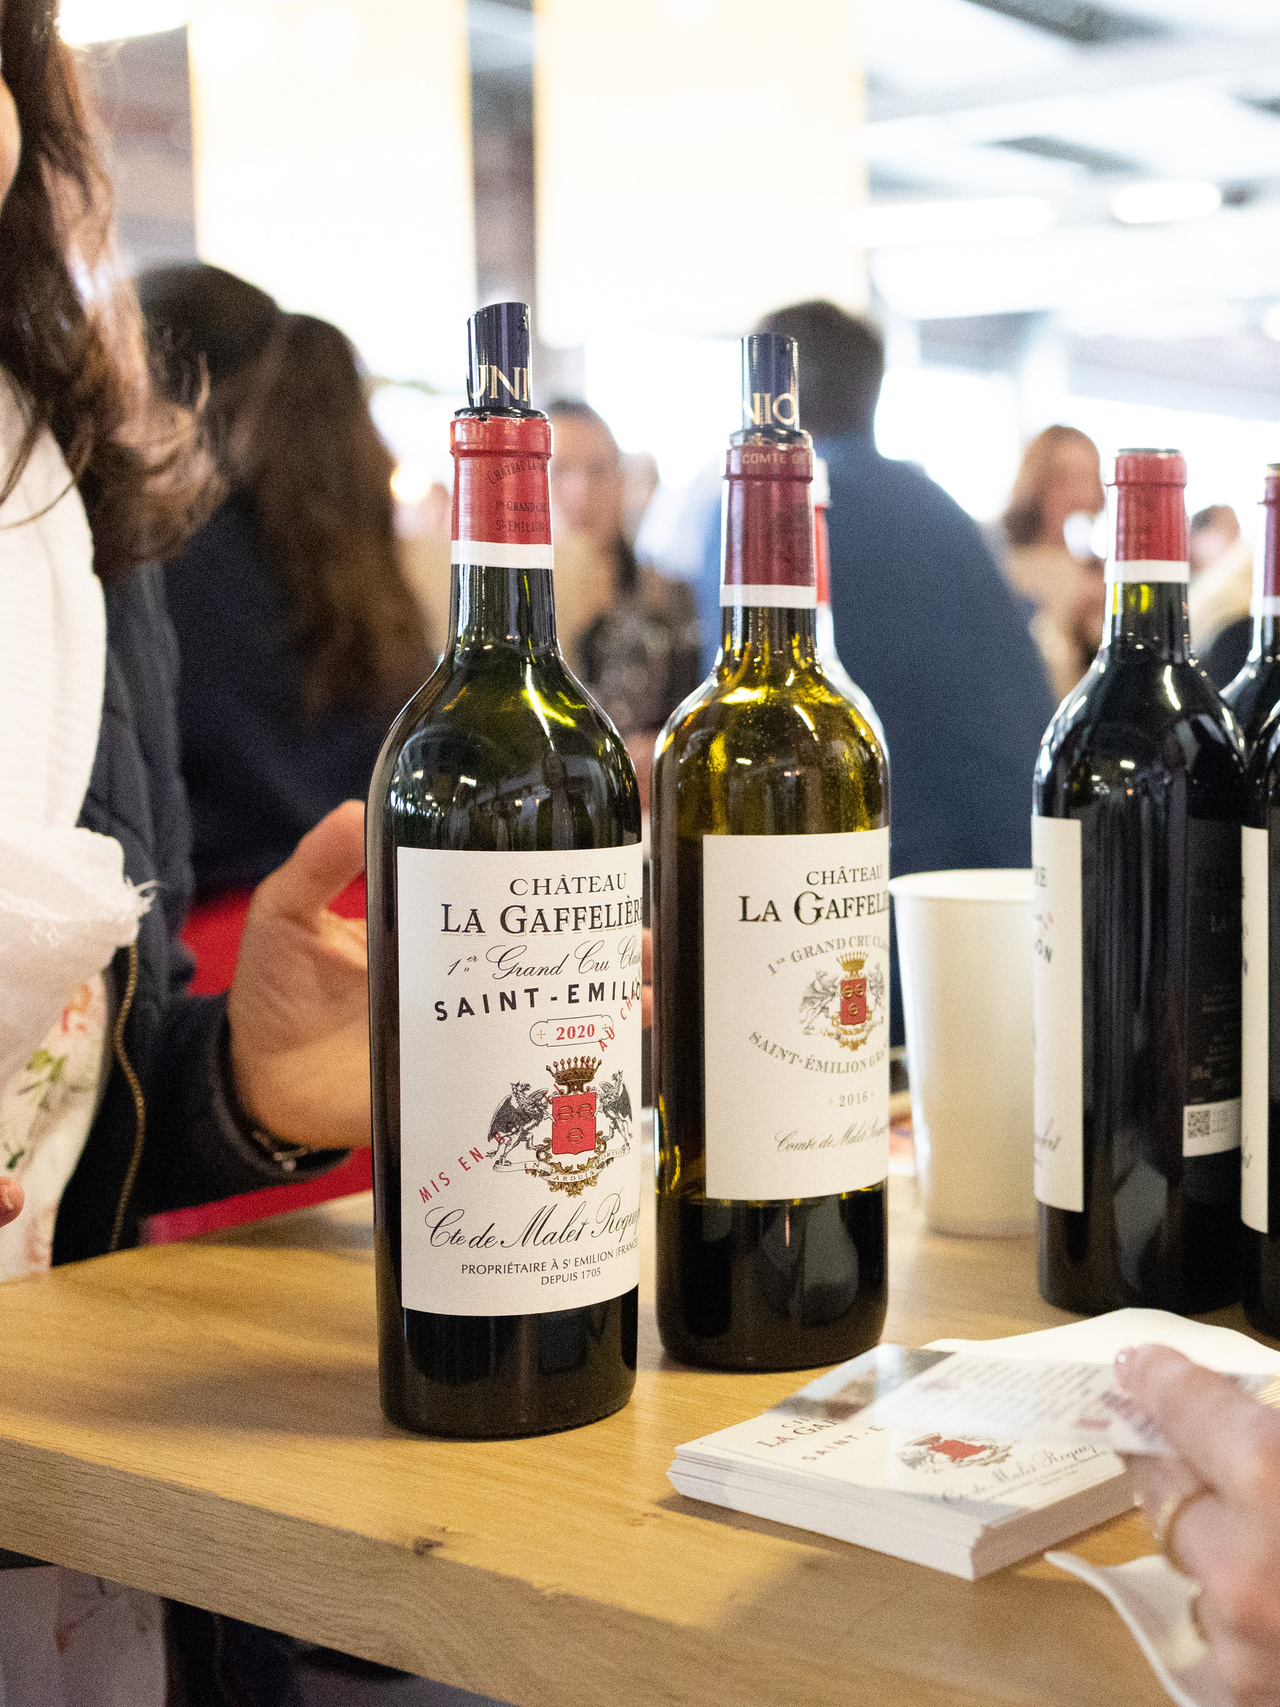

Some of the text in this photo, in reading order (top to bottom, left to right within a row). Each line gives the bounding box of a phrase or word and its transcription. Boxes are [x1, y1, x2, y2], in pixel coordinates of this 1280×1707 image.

[510, 873, 627, 896] CHÂTEAU
[806, 864, 882, 886] CHÂTEAU
[441, 903, 485, 933] LA
[738, 895, 782, 922] LA
[486, 945, 570, 979] Grand
[574, 940, 609, 974] Cru
[790, 938, 846, 963] GRAND
[849, 935, 872, 948] CRU
[556, 1023, 596, 1041] 2020
[839, 1090, 868, 1107] 2016
[418, 1171, 451, 1203] MIS
[458, 1147, 484, 1172] EN
[469, 1222, 498, 1248] de
[500, 1200, 590, 1248] Malet
[461, 1261, 547, 1275] PROPRIÉTAIRE
[551, 1258, 559, 1271] À
[574, 1249, 614, 1268] EMILION
[541, 1267, 601, 1286] DEPUIS 1705
